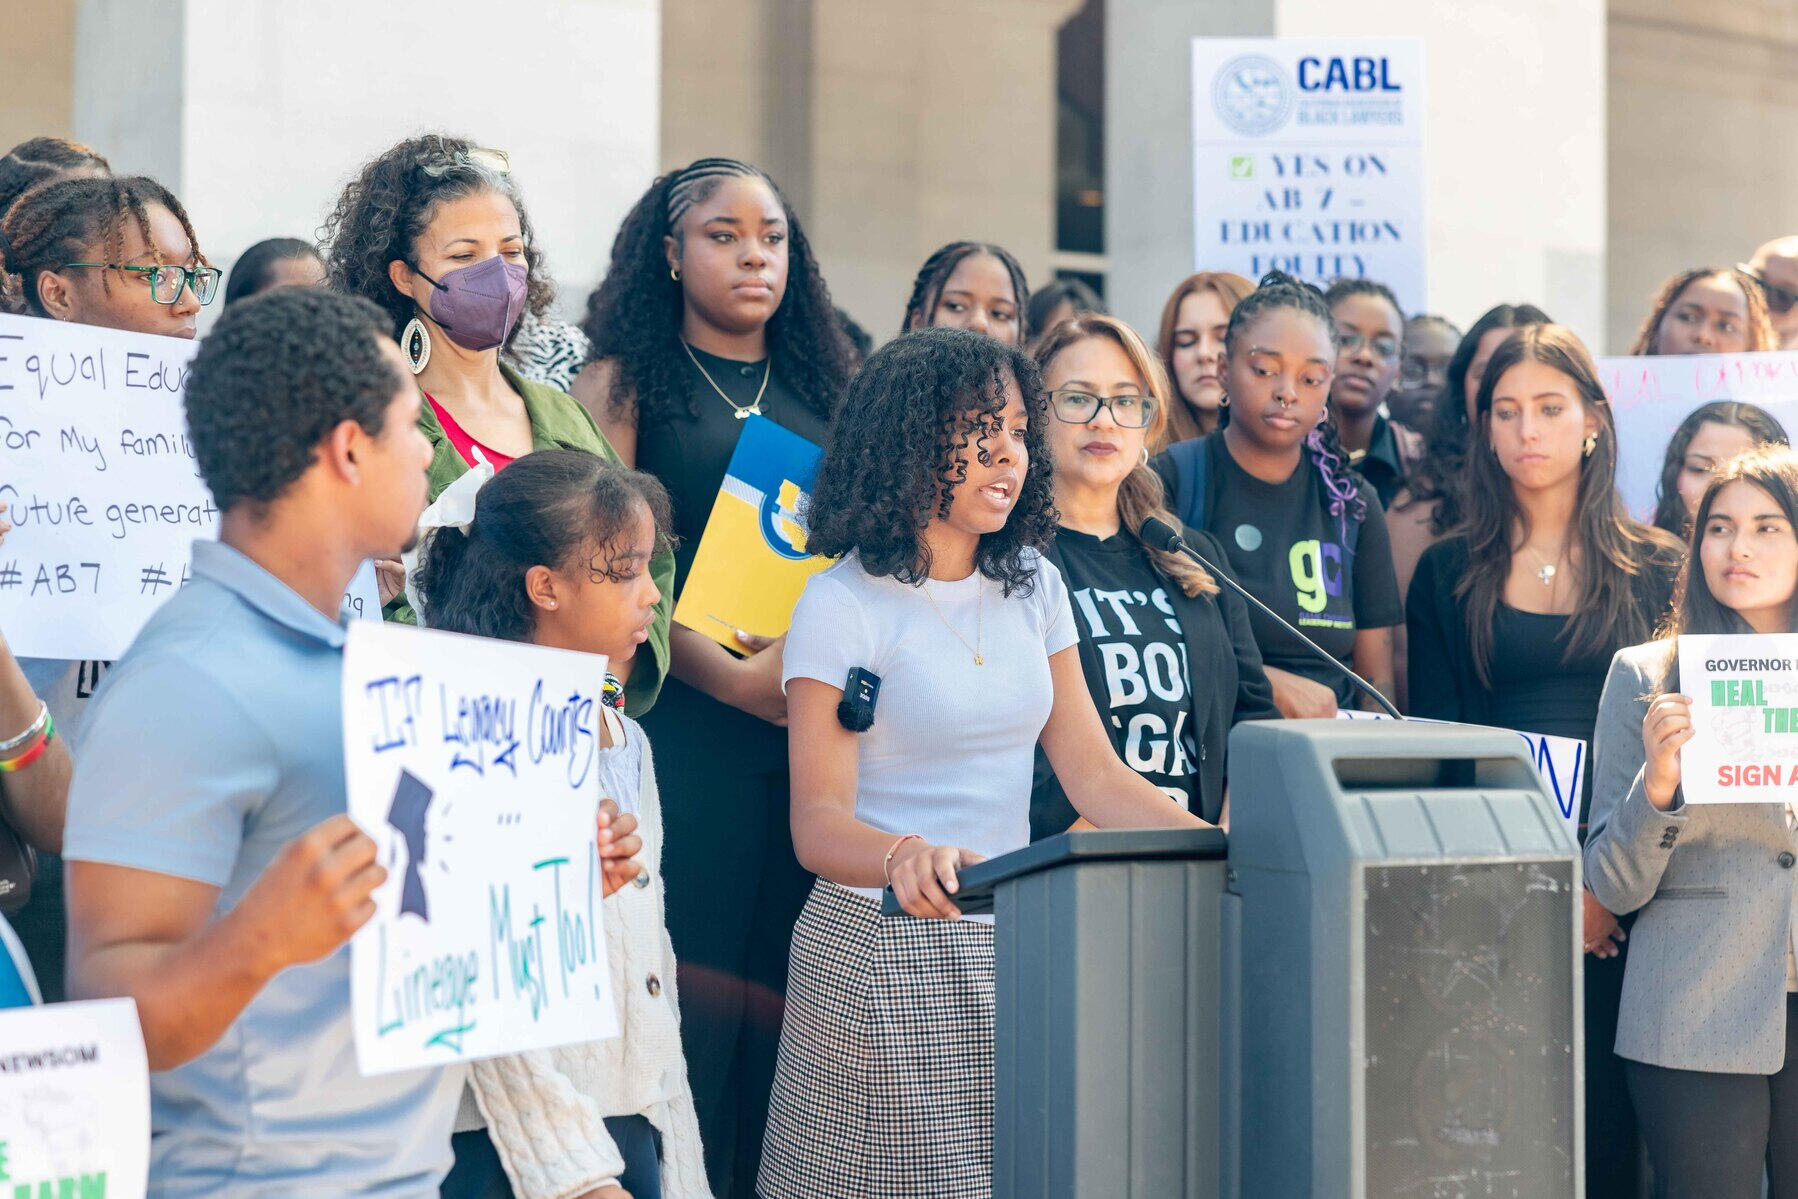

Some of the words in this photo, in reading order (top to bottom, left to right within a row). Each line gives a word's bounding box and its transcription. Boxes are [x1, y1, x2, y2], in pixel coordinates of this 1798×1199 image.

[1298, 56, 1401, 92] CABL
[1271, 154, 1330, 177] YES
[1343, 154, 1387, 176] ON
[1264, 188, 1301, 211] AB
[1219, 220, 1401, 244] EDUCATION
[1250, 254, 1367, 278] EQUITY
[60, 426, 107, 471] My
[0, 560, 100, 597] #AB7
[1073, 587, 1183, 638] IT'S
[1098, 641, 1192, 709] BO
[1705, 659, 1792, 672] GOVERNOR
[1711, 680, 1768, 707] HEAL
[1717, 765, 1782, 786] SIGN
[490, 883, 549, 1022] Must
[533, 841, 600, 1000] Too!
